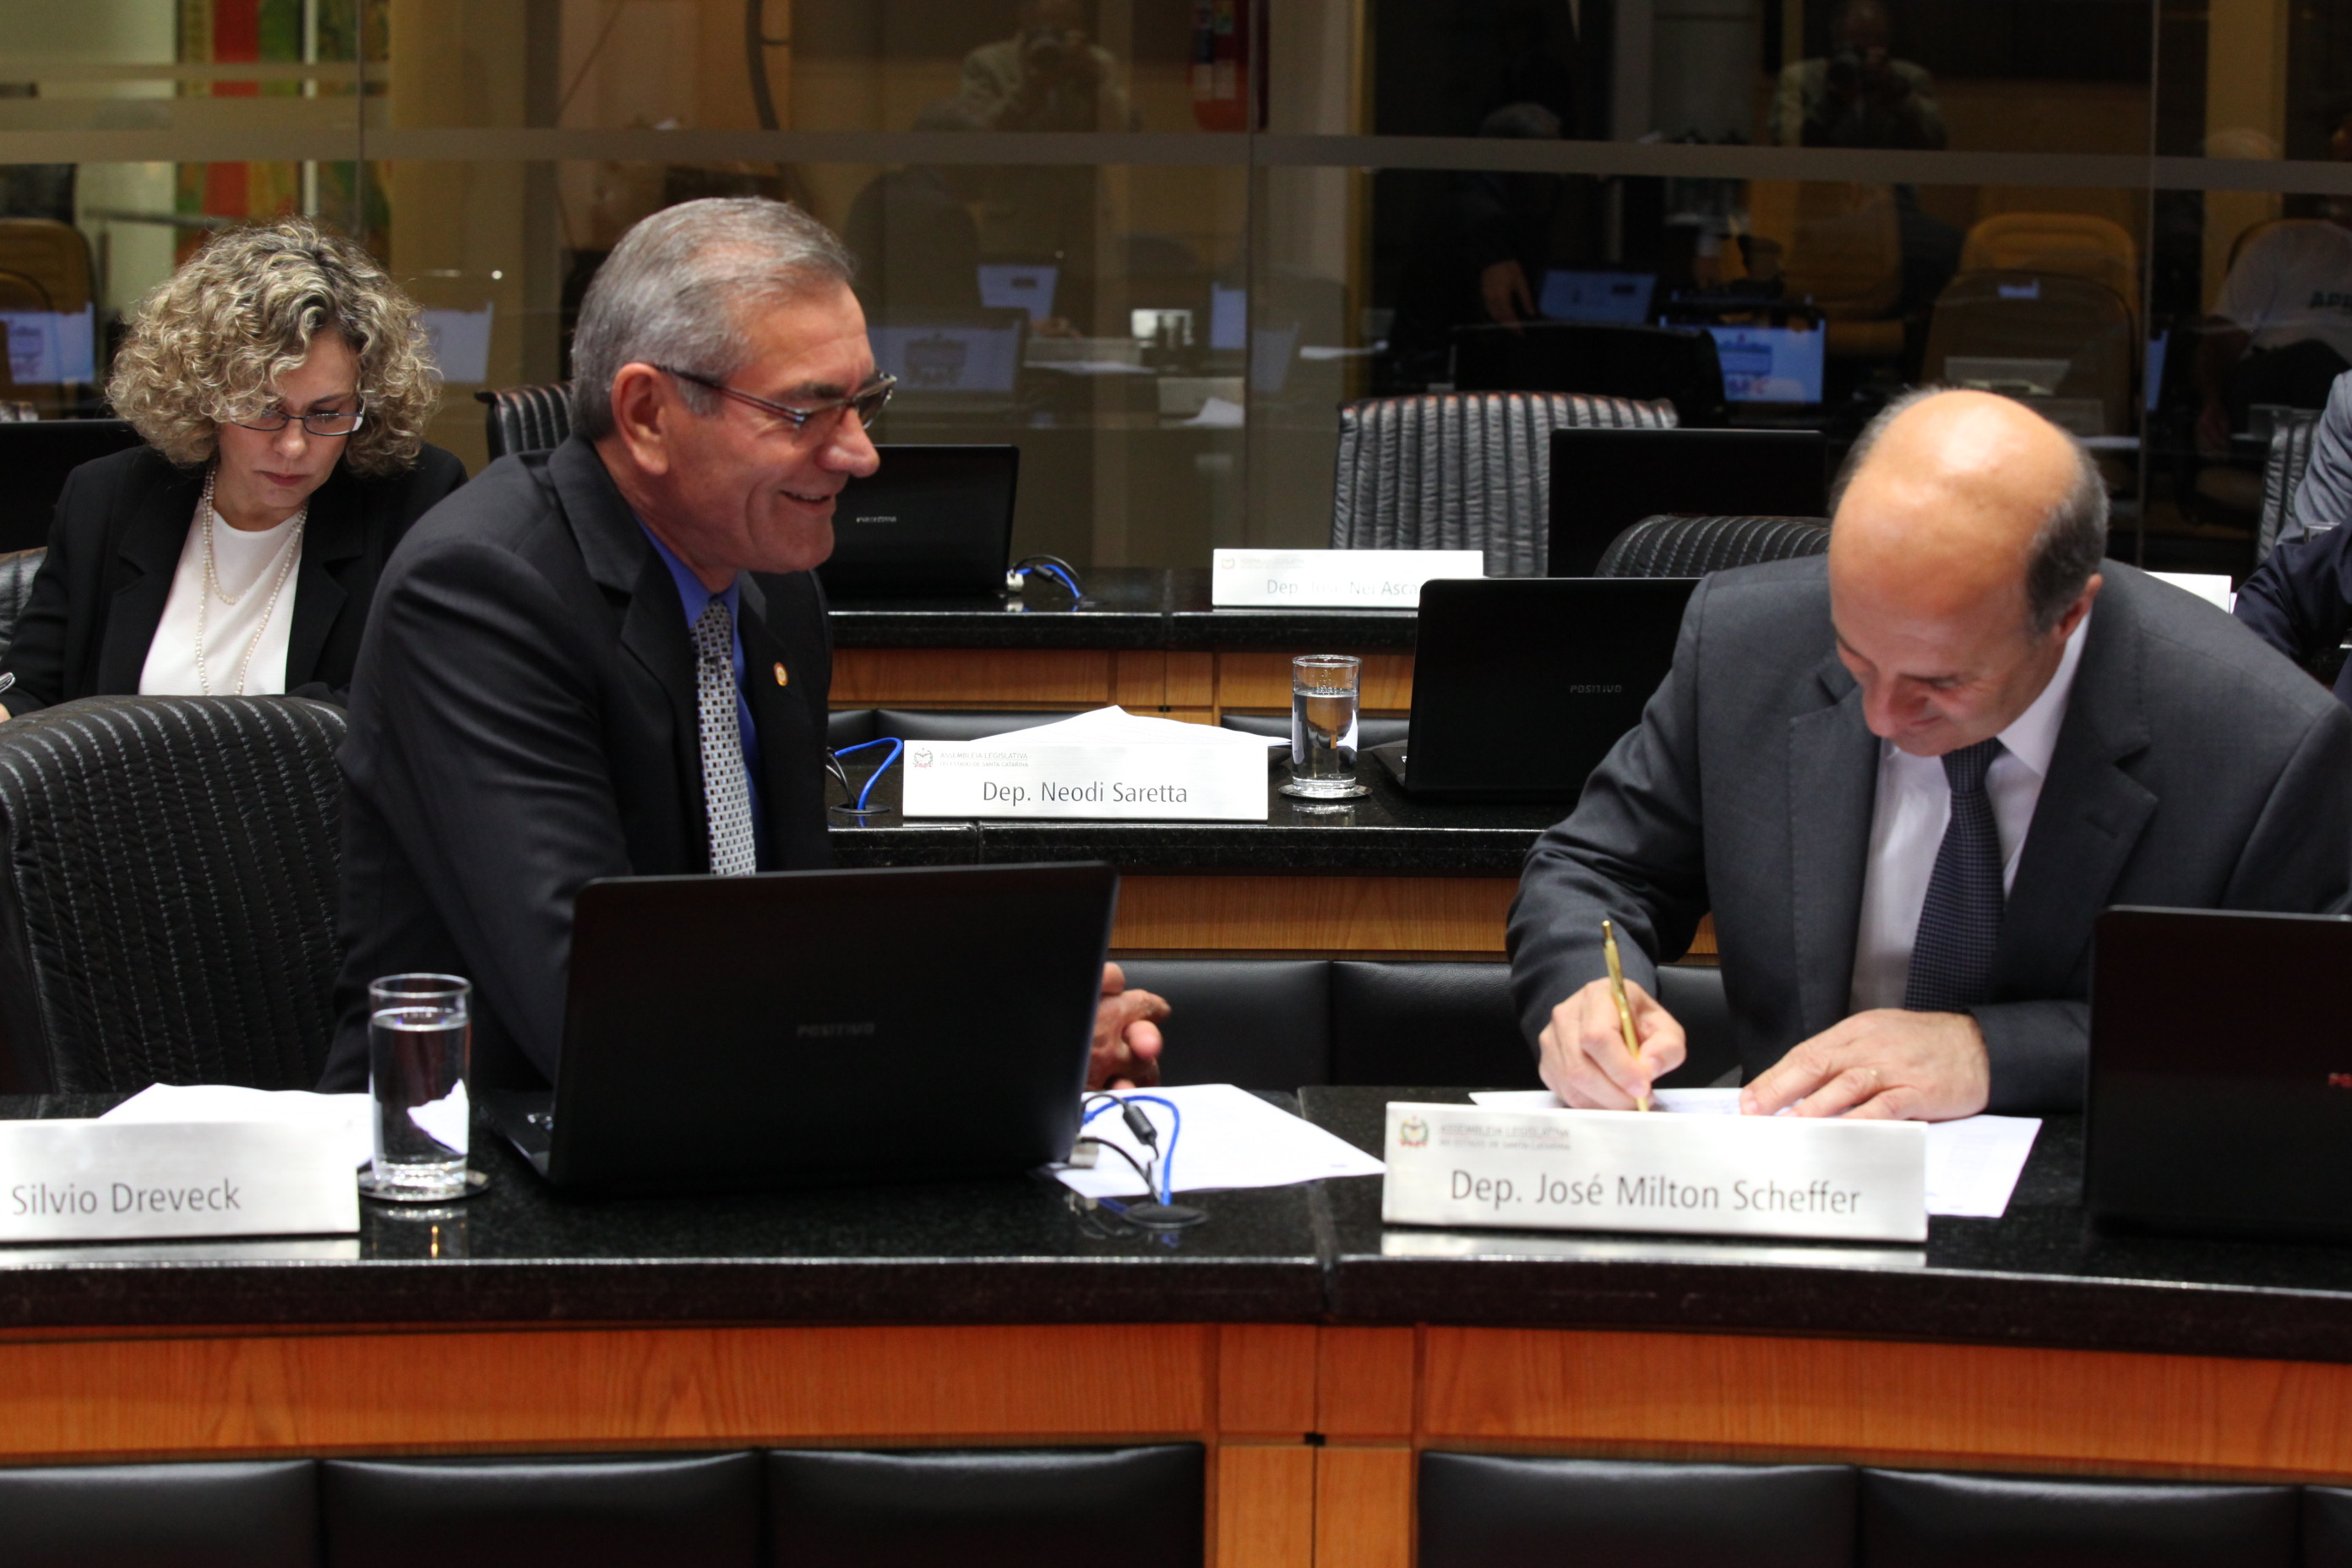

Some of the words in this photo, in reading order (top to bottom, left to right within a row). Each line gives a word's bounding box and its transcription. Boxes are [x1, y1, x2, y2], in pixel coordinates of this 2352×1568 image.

[983, 781, 1031, 808] Dep.
[1041, 781, 1104, 802] Neodi
[1113, 781, 1187, 803] Saretta
[12, 1184, 97, 1214] Silvio
[112, 1179, 241, 1213] Dreveck
[1451, 1169, 1522, 1210] Dep.
[1535, 1173, 1603, 1206] José
[1618, 1175, 1718, 1209] Milton
[1734, 1180, 1861, 1214] Scheffer
